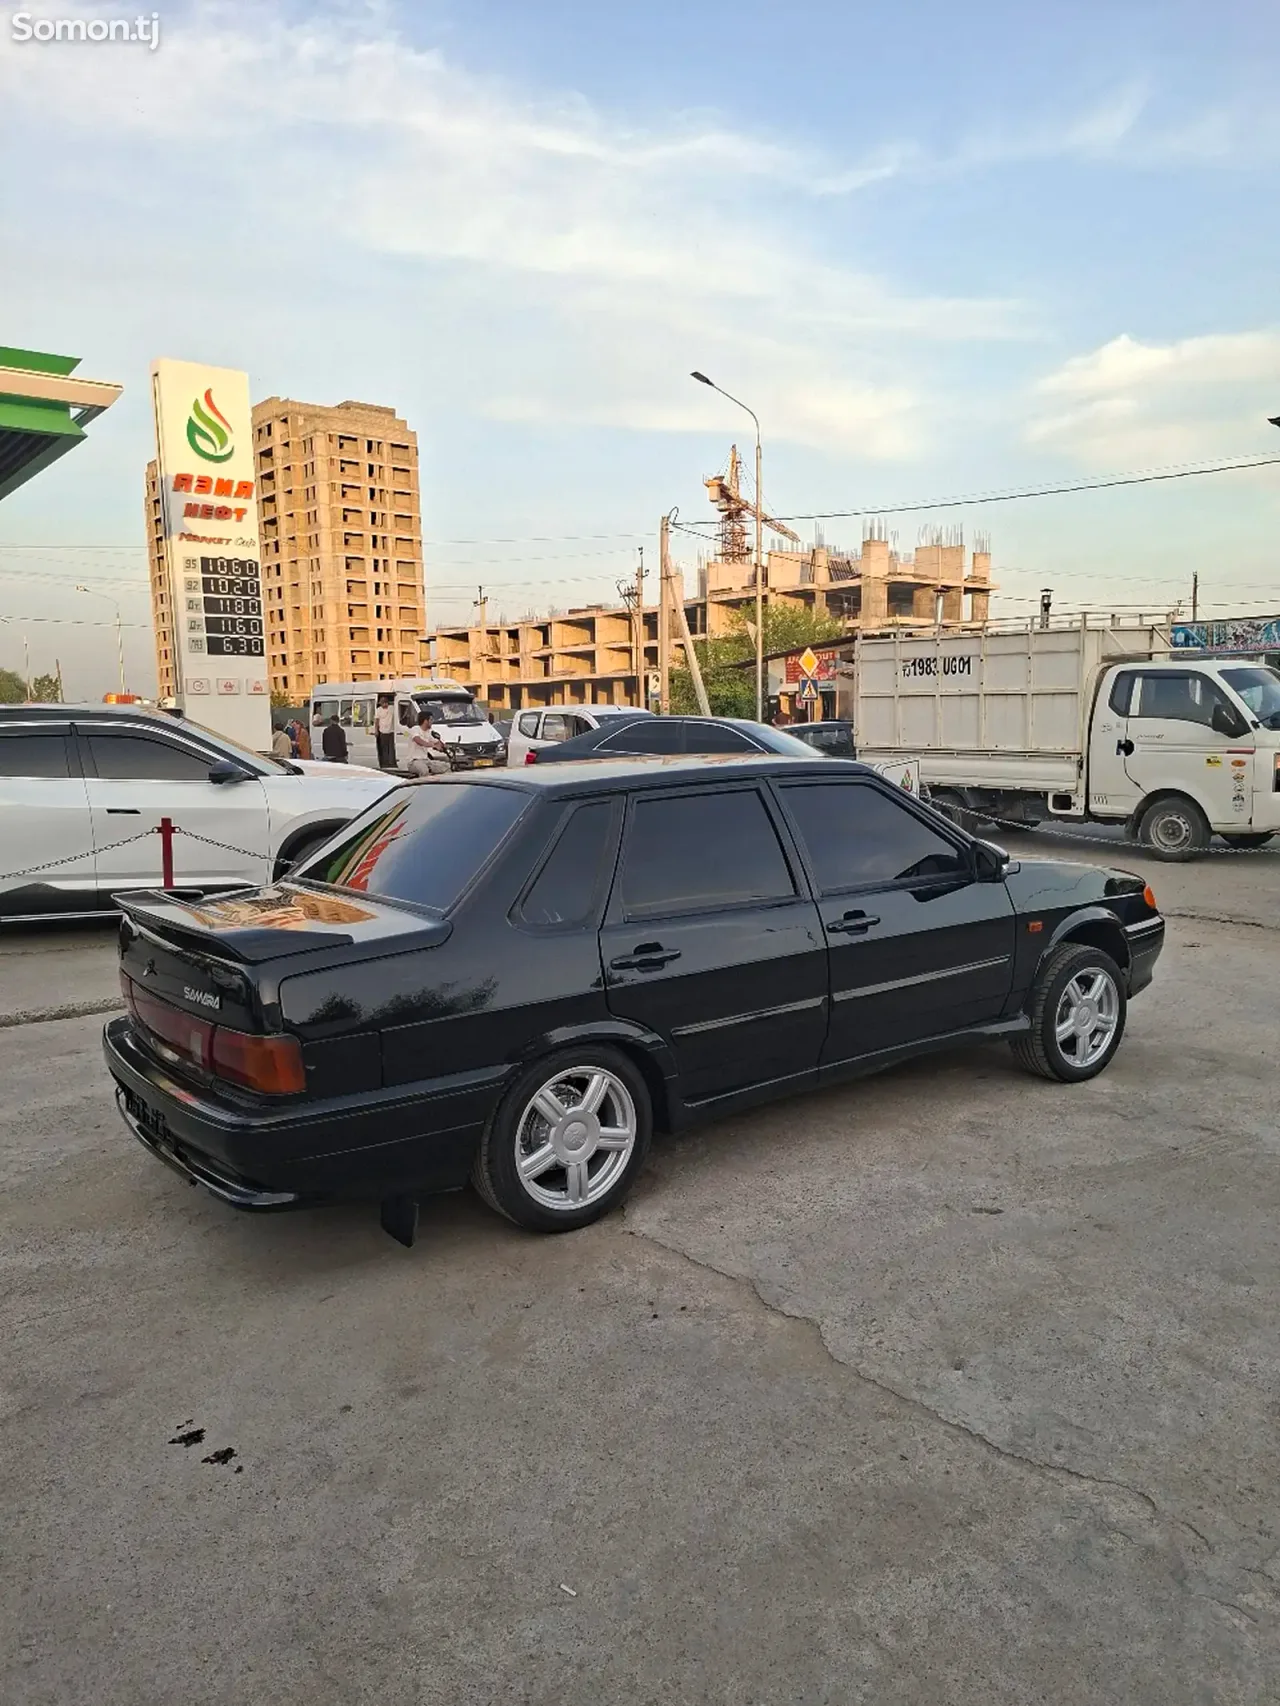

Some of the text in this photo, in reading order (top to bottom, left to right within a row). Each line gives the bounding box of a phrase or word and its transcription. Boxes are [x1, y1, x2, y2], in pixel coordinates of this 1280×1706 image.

[172, 473, 256, 499] АЗИЯ
[183, 502, 248, 522] НЕФТ
[184, 558, 256, 576] 95 10.60
[186, 577, 257, 595] 92 10.20
[223, 637, 261, 654] 6.30
[183, 986, 220, 1009] SAMARA
